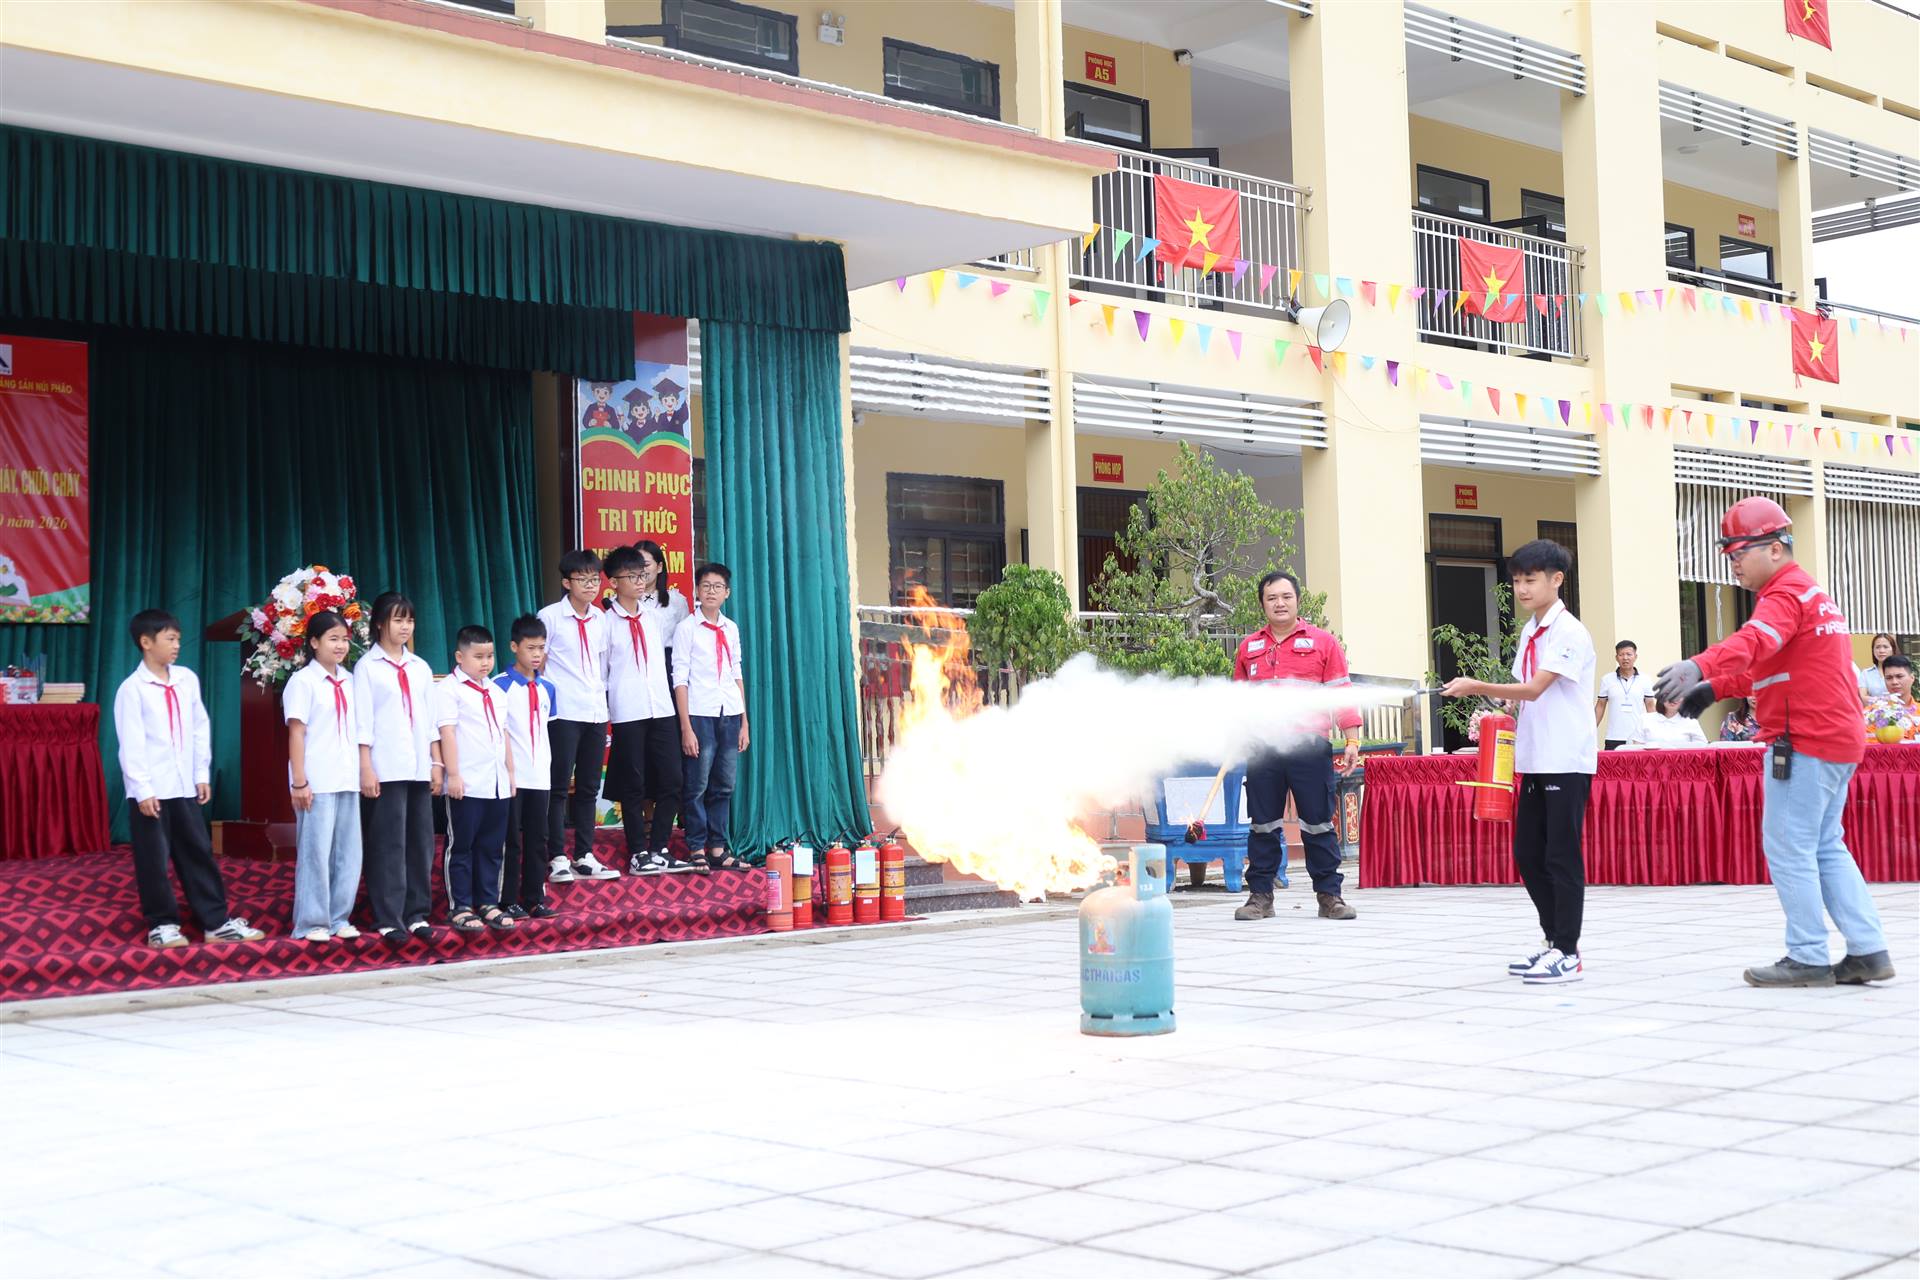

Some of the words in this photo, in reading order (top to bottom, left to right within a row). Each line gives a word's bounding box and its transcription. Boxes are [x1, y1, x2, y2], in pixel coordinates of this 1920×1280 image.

[1094, 66, 1110, 81] A5
[1095, 459, 1111, 475] PHÒNG
[21, 466, 50, 496] CHỮA
[53, 467, 80, 497] CHÁY
[582, 466, 640, 493] CHINH
[644, 470, 691, 499] PHỤC
[7, 515, 34, 529] năm
[39, 515, 68, 530] 2026
[598, 508, 628, 532] TRI
[632, 506, 678, 535] THỨC
